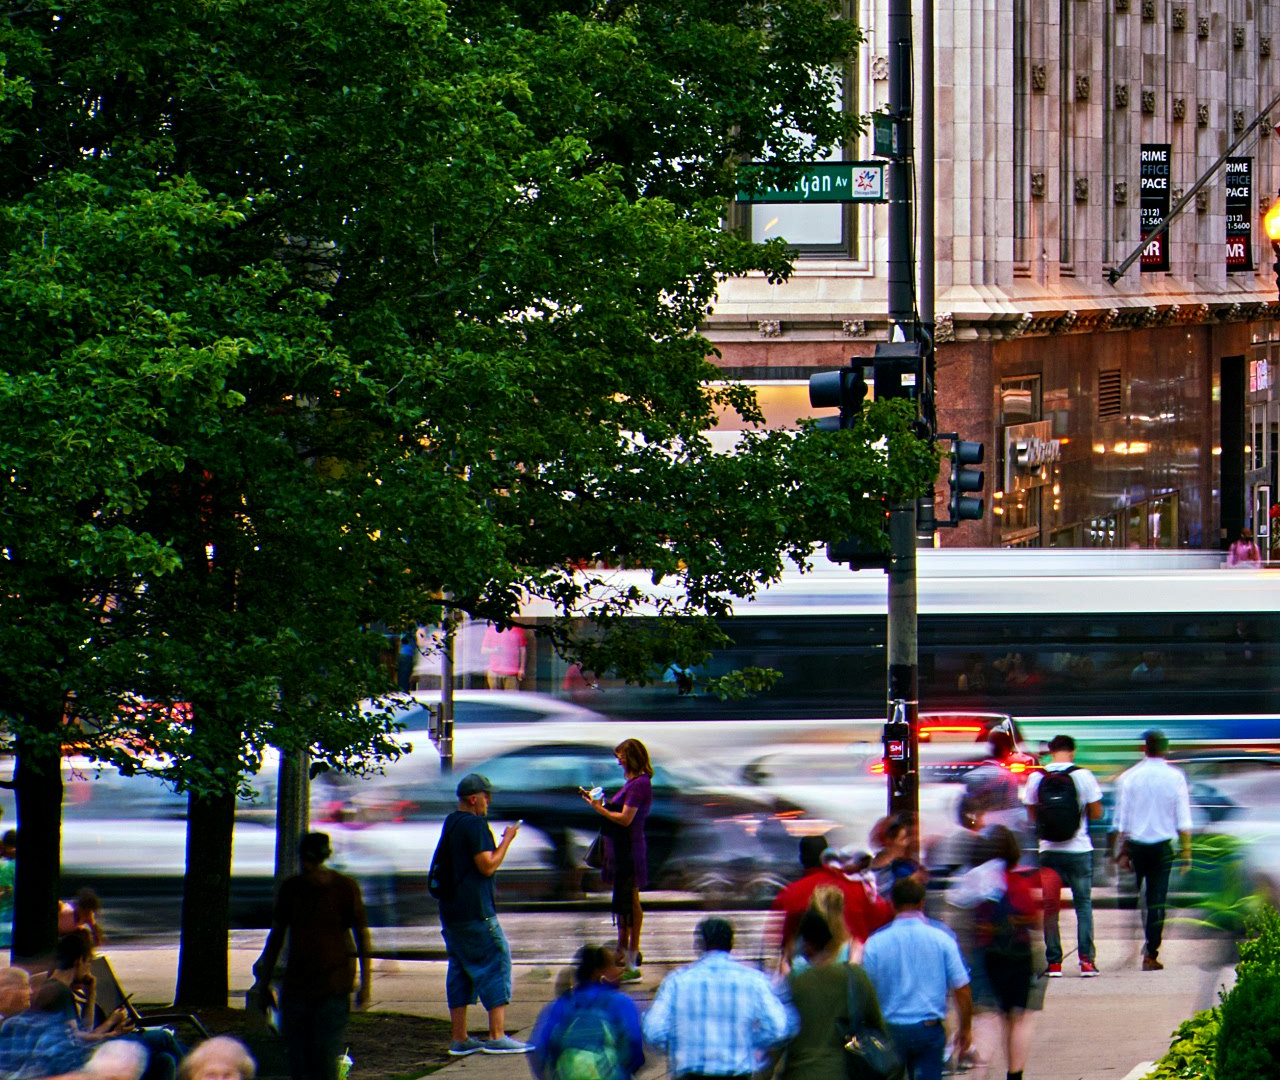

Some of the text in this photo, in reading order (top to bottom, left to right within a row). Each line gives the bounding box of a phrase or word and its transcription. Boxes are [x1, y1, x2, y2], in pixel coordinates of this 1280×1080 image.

[1141, 151, 1167, 161] RIME
[1142, 165, 1168, 175] FFICE
[1226, 163, 1248, 172] RIME
[836, 178, 848, 187] Av
[1141, 179, 1167, 189] PACE
[1227, 176, 1250, 185] FFICE
[1226, 188, 1249, 197] PACE
